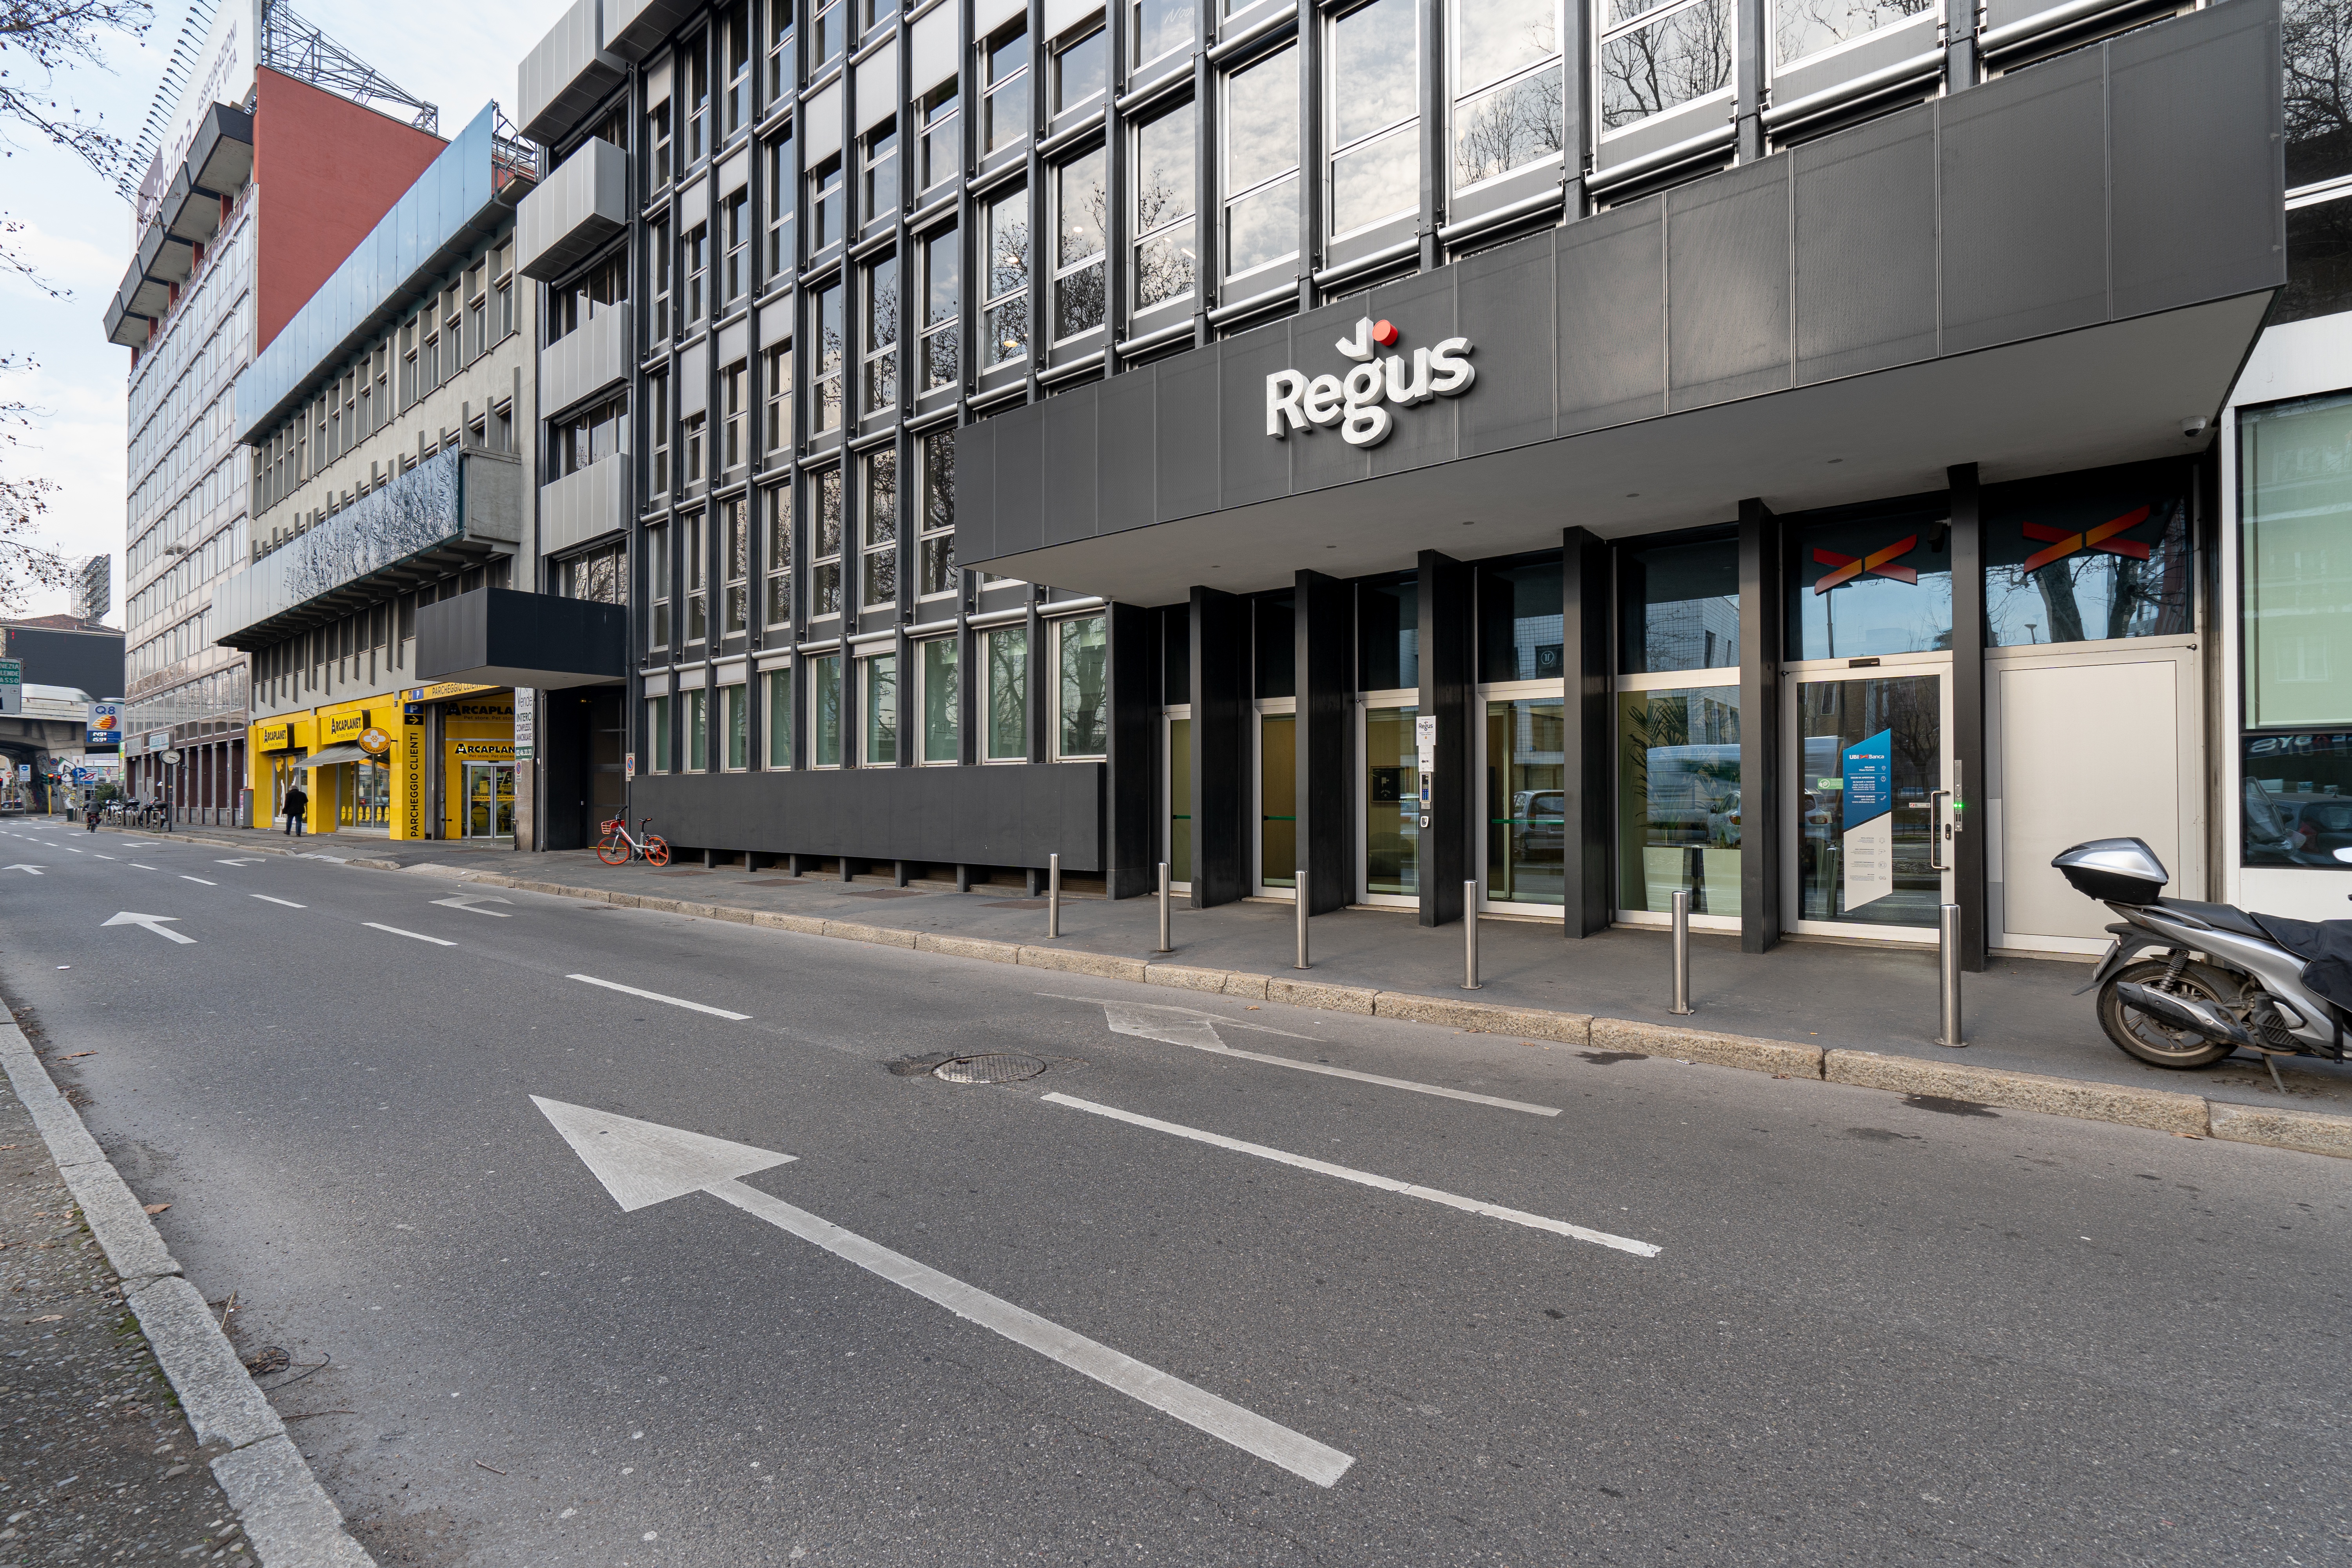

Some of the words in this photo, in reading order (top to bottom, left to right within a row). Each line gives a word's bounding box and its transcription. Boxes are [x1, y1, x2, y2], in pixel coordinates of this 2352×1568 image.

[198, 19, 237, 116] ASSICURAZIONI
[217, 79, 220, 100] E
[223, 47, 237, 85] VITA
[1267, 337, 1475, 448] Regus
[416, 690, 420, 699] P
[432, 682, 462, 696] PARCHEGGIO
[516, 688, 532, 707] Vende
[95, 706, 115, 714] Q8
[516, 712, 532, 723] INTERO
[331, 717, 361, 735] ARCAPLANET
[516, 723, 532, 732] COMPLESSO
[264, 729, 286, 743] ARCAPLANET
[516, 733, 532, 742] IMMOBILIARE
[361, 742, 390, 753] PARAFARMACIA
[410, 733, 418, 770] CLIENTI
[410, 773, 418, 837] PARCHEGGIO
